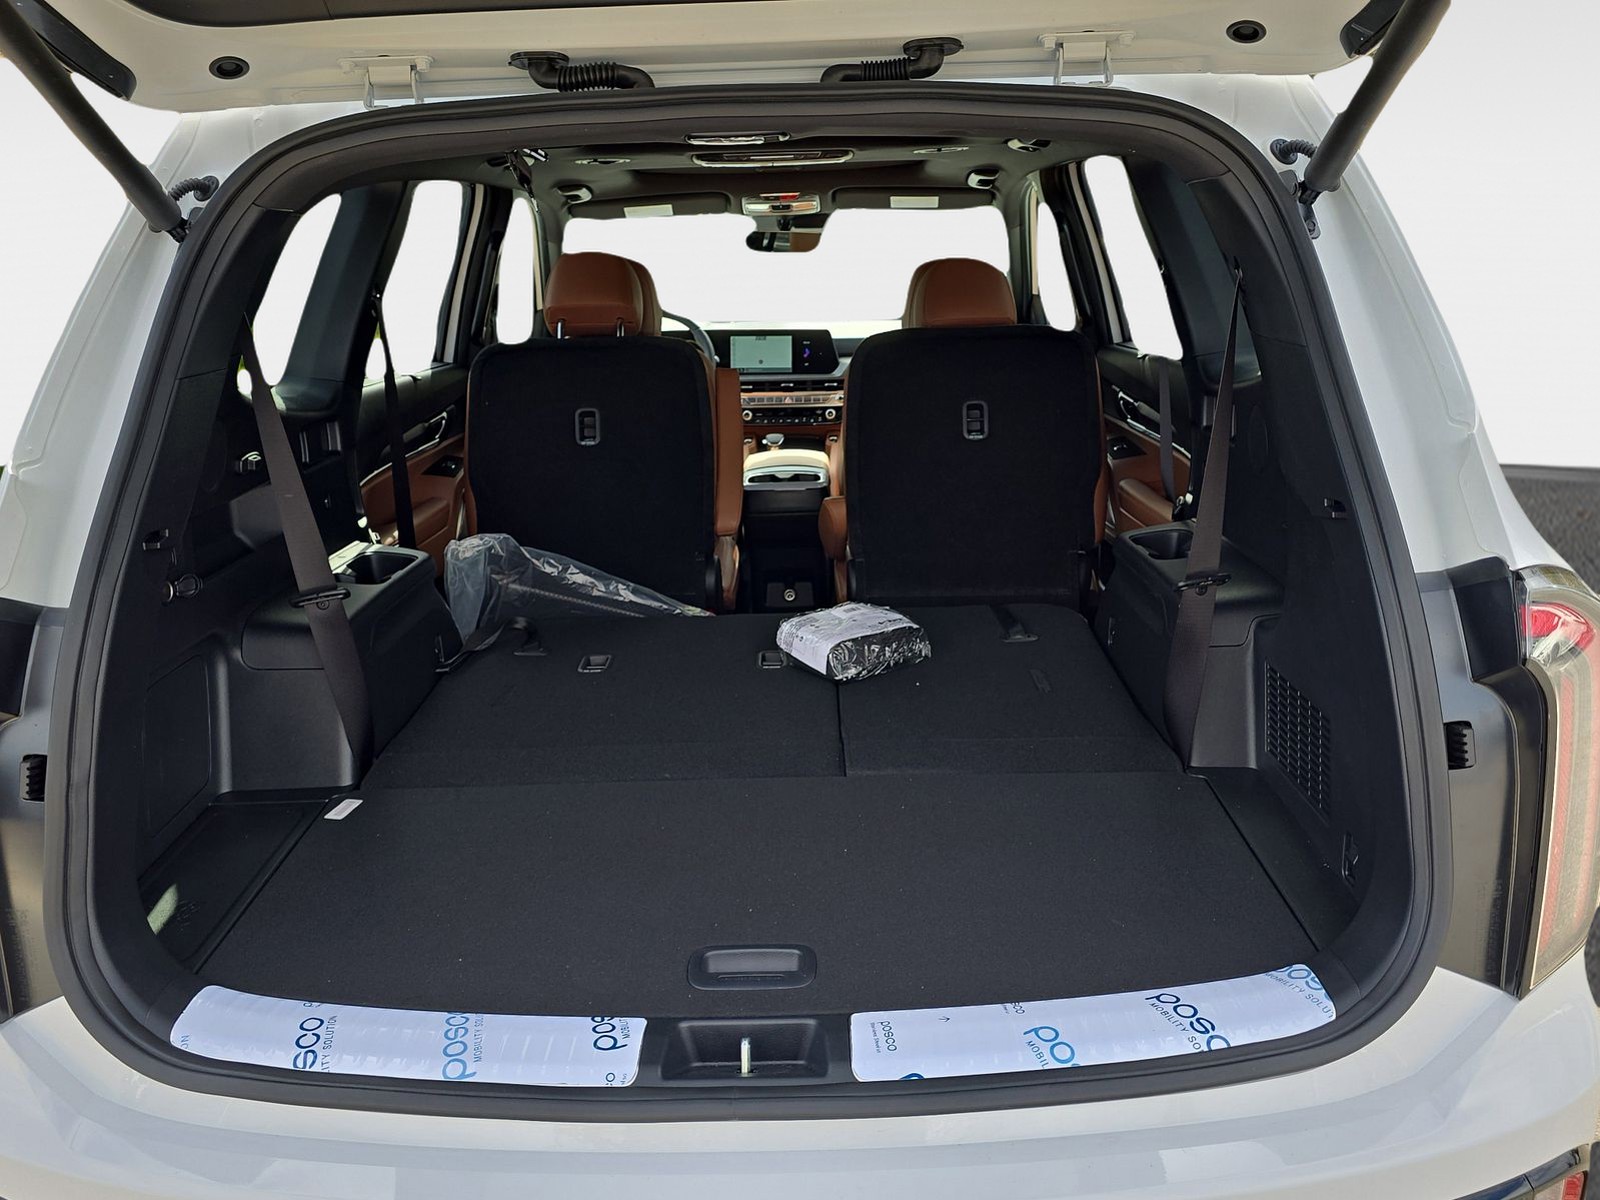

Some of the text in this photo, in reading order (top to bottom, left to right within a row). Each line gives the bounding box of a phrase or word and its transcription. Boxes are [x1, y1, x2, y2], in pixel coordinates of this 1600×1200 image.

[877, 1021, 897, 1052] posco
[1149, 1002, 1204, 1051] MOBILITY SO
[442, 1012, 477, 1080] posc
[473, 1029, 483, 1063] MOBILITY
[1023, 1026, 1080, 1067] po
[1026, 1040, 1049, 1069] MOBIL
[320, 1054, 330, 1073] ITY
